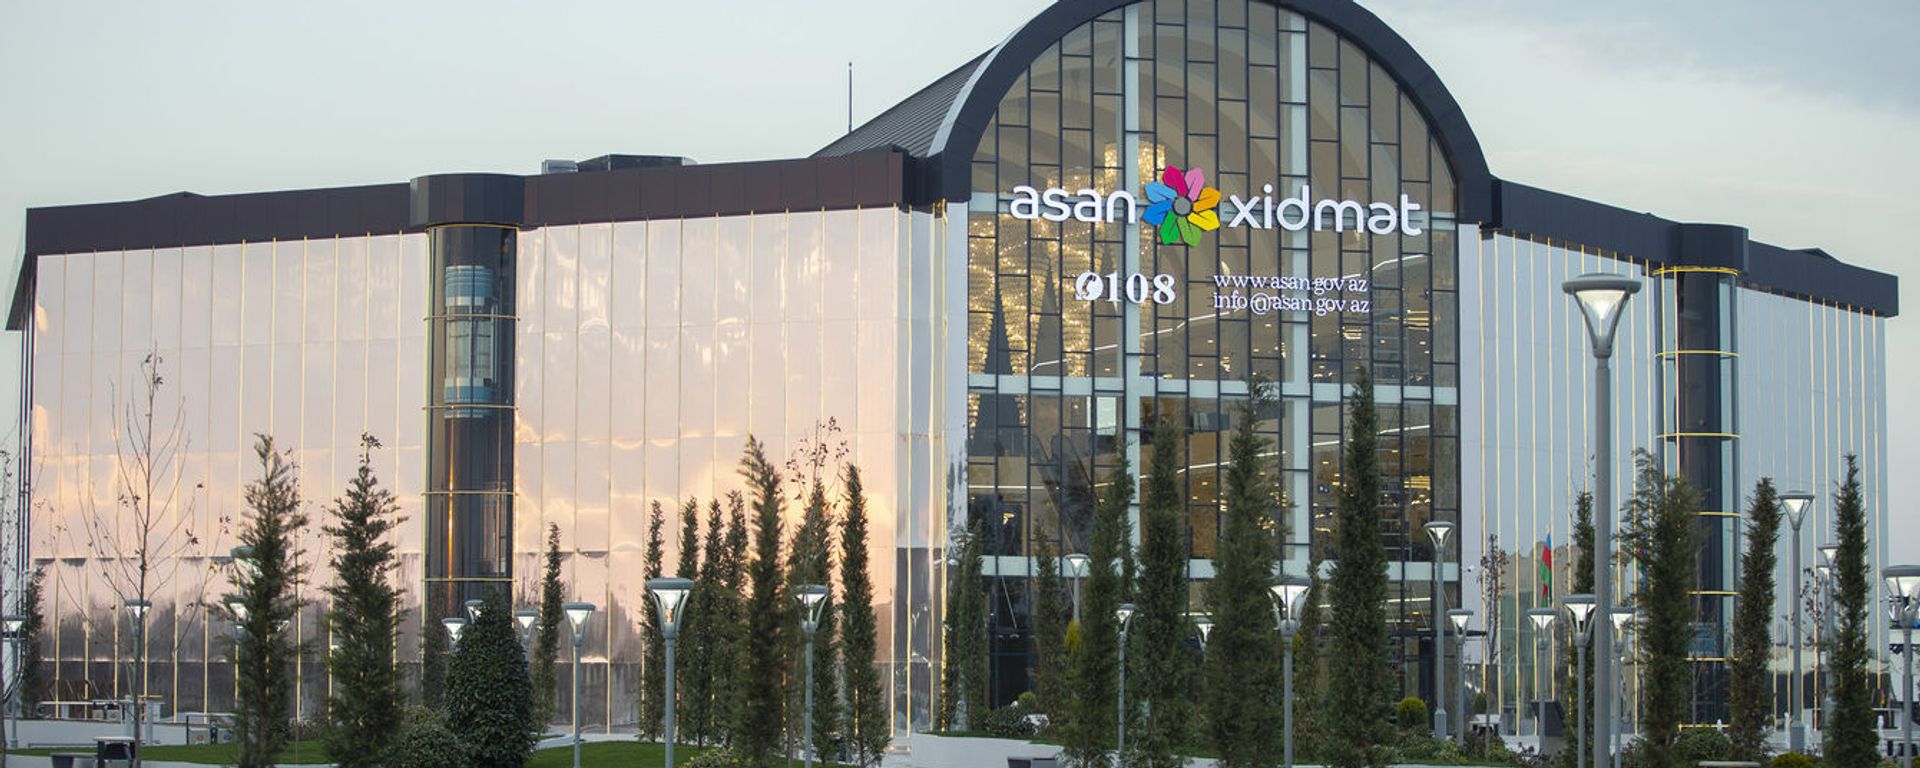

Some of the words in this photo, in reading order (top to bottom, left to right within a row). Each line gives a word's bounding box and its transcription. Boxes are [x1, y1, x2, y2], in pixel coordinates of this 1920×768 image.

[1010, 185, 1136, 224] asan
[1105, 270, 1176, 305] 108
[1213, 274, 1369, 295] www.asan.gov.az
[1213, 289, 1370, 316] info@asan.gov.az
